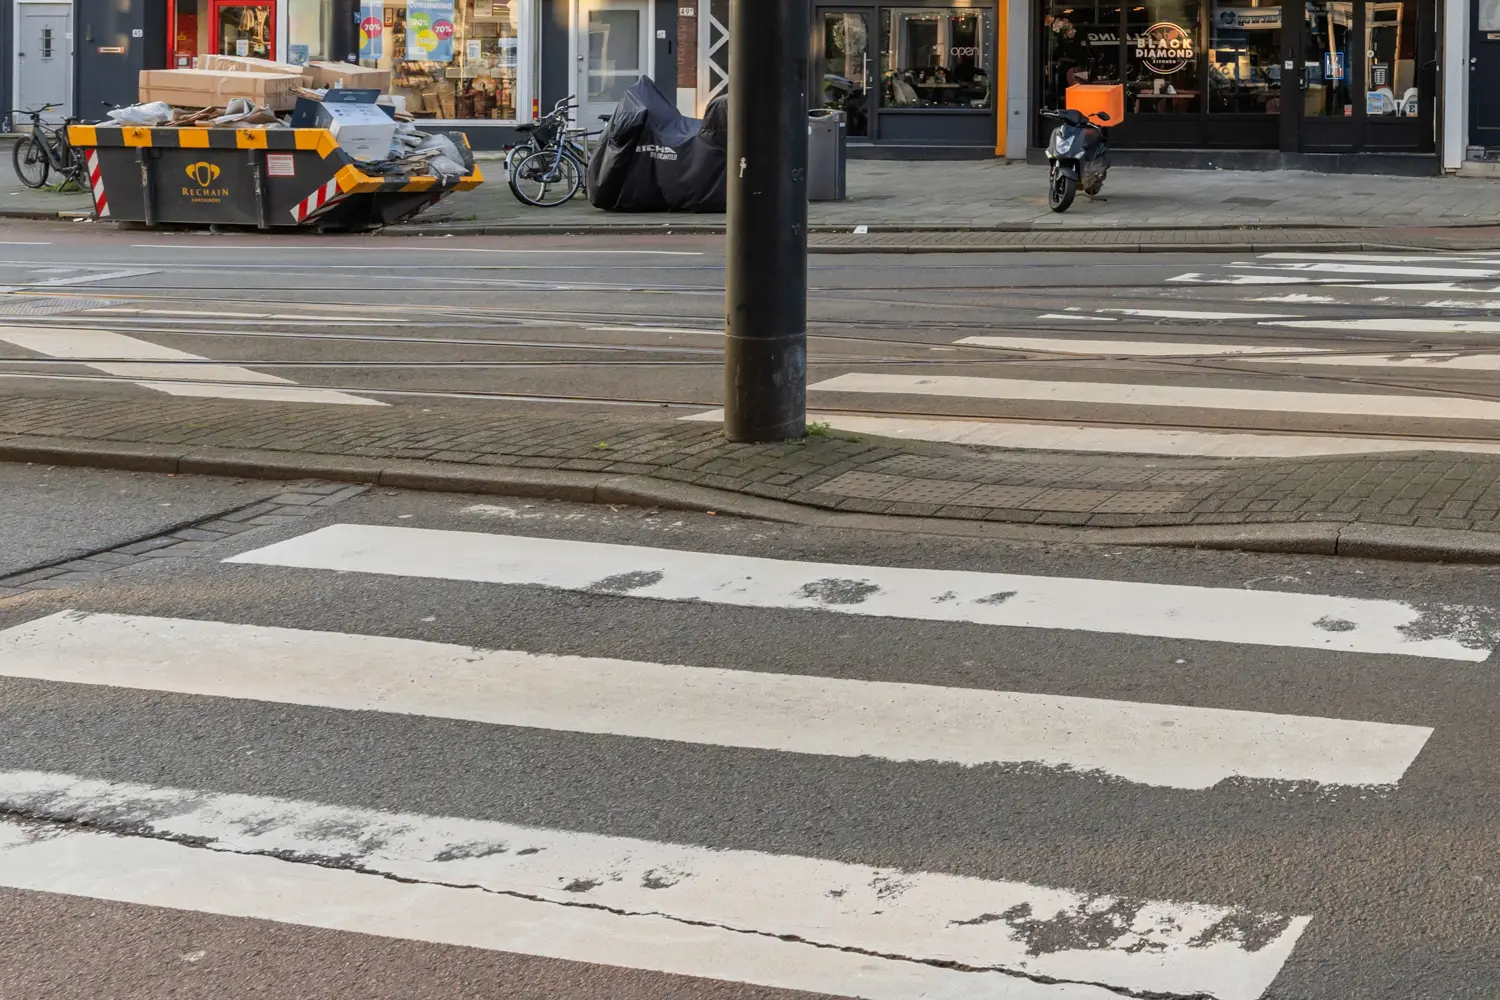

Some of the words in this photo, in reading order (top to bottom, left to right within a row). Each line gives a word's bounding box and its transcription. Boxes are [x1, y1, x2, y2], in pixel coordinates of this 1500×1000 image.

[364, 23, 381, 31] 70%
[435, 25, 452, 33] 70%
[1137, 38, 1193, 49] BLACK
[950, 46, 980, 58] open
[1135, 49, 1193, 58] DIAMOND
[181, 187, 229, 196] RECHAIN
